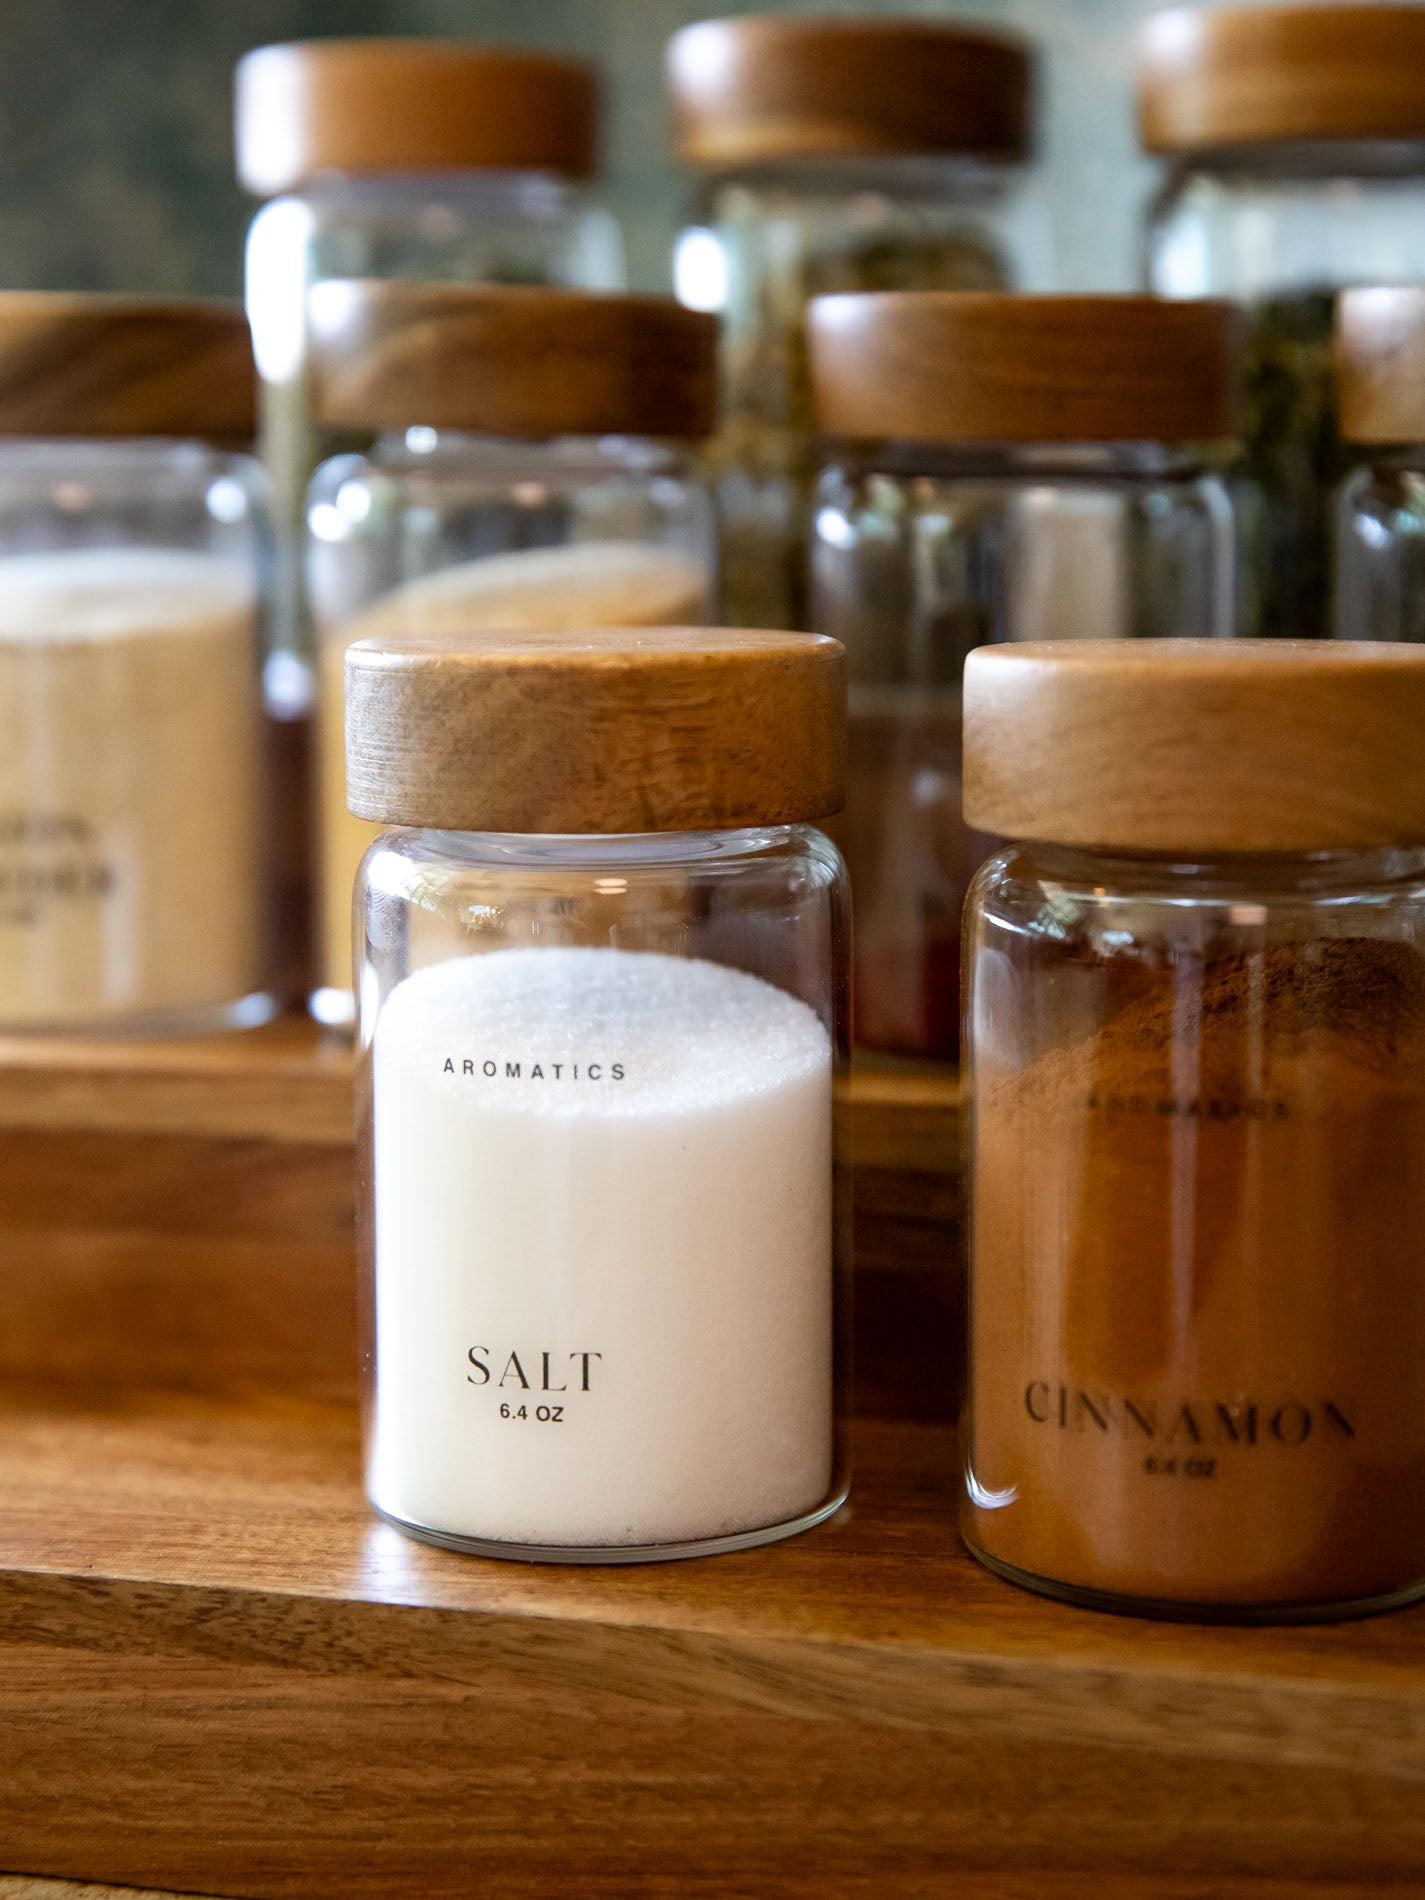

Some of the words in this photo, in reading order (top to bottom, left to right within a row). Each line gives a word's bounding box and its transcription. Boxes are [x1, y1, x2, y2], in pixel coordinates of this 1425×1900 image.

[443, 1057, 625, 1081] AROMATICS
[467, 1345, 602, 1392] SALT
[500, 1403, 528, 1420] 6.4
[535, 1405, 565, 1423] OZ
[1024, 1380, 1355, 1445] CINNAMON
